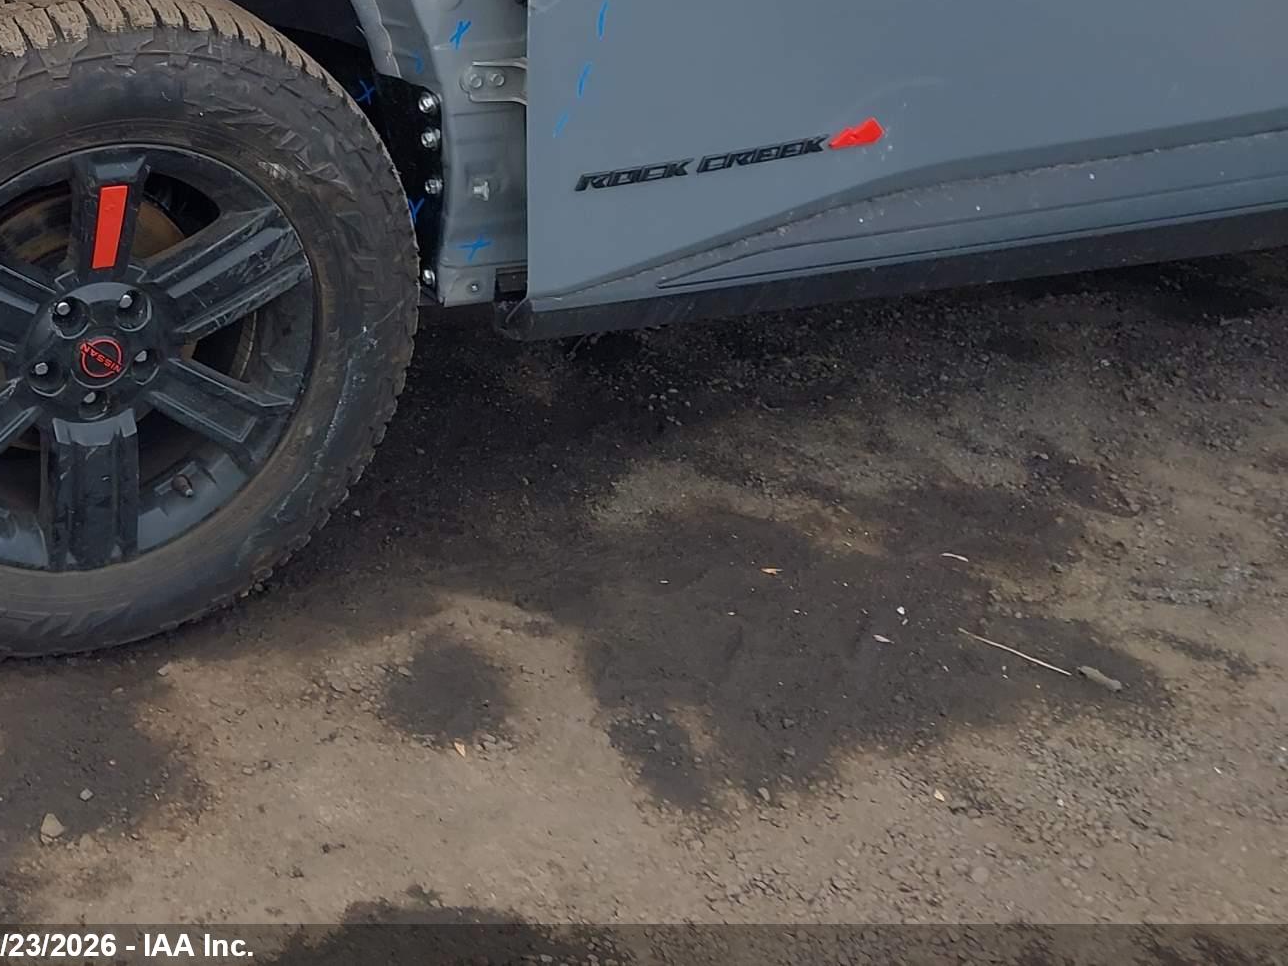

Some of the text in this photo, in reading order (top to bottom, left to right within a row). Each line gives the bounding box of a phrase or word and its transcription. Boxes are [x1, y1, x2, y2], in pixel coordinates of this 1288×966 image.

[574, 134, 830, 192] ROCK CREEK
[79, 342, 122, 374] NISSAN
